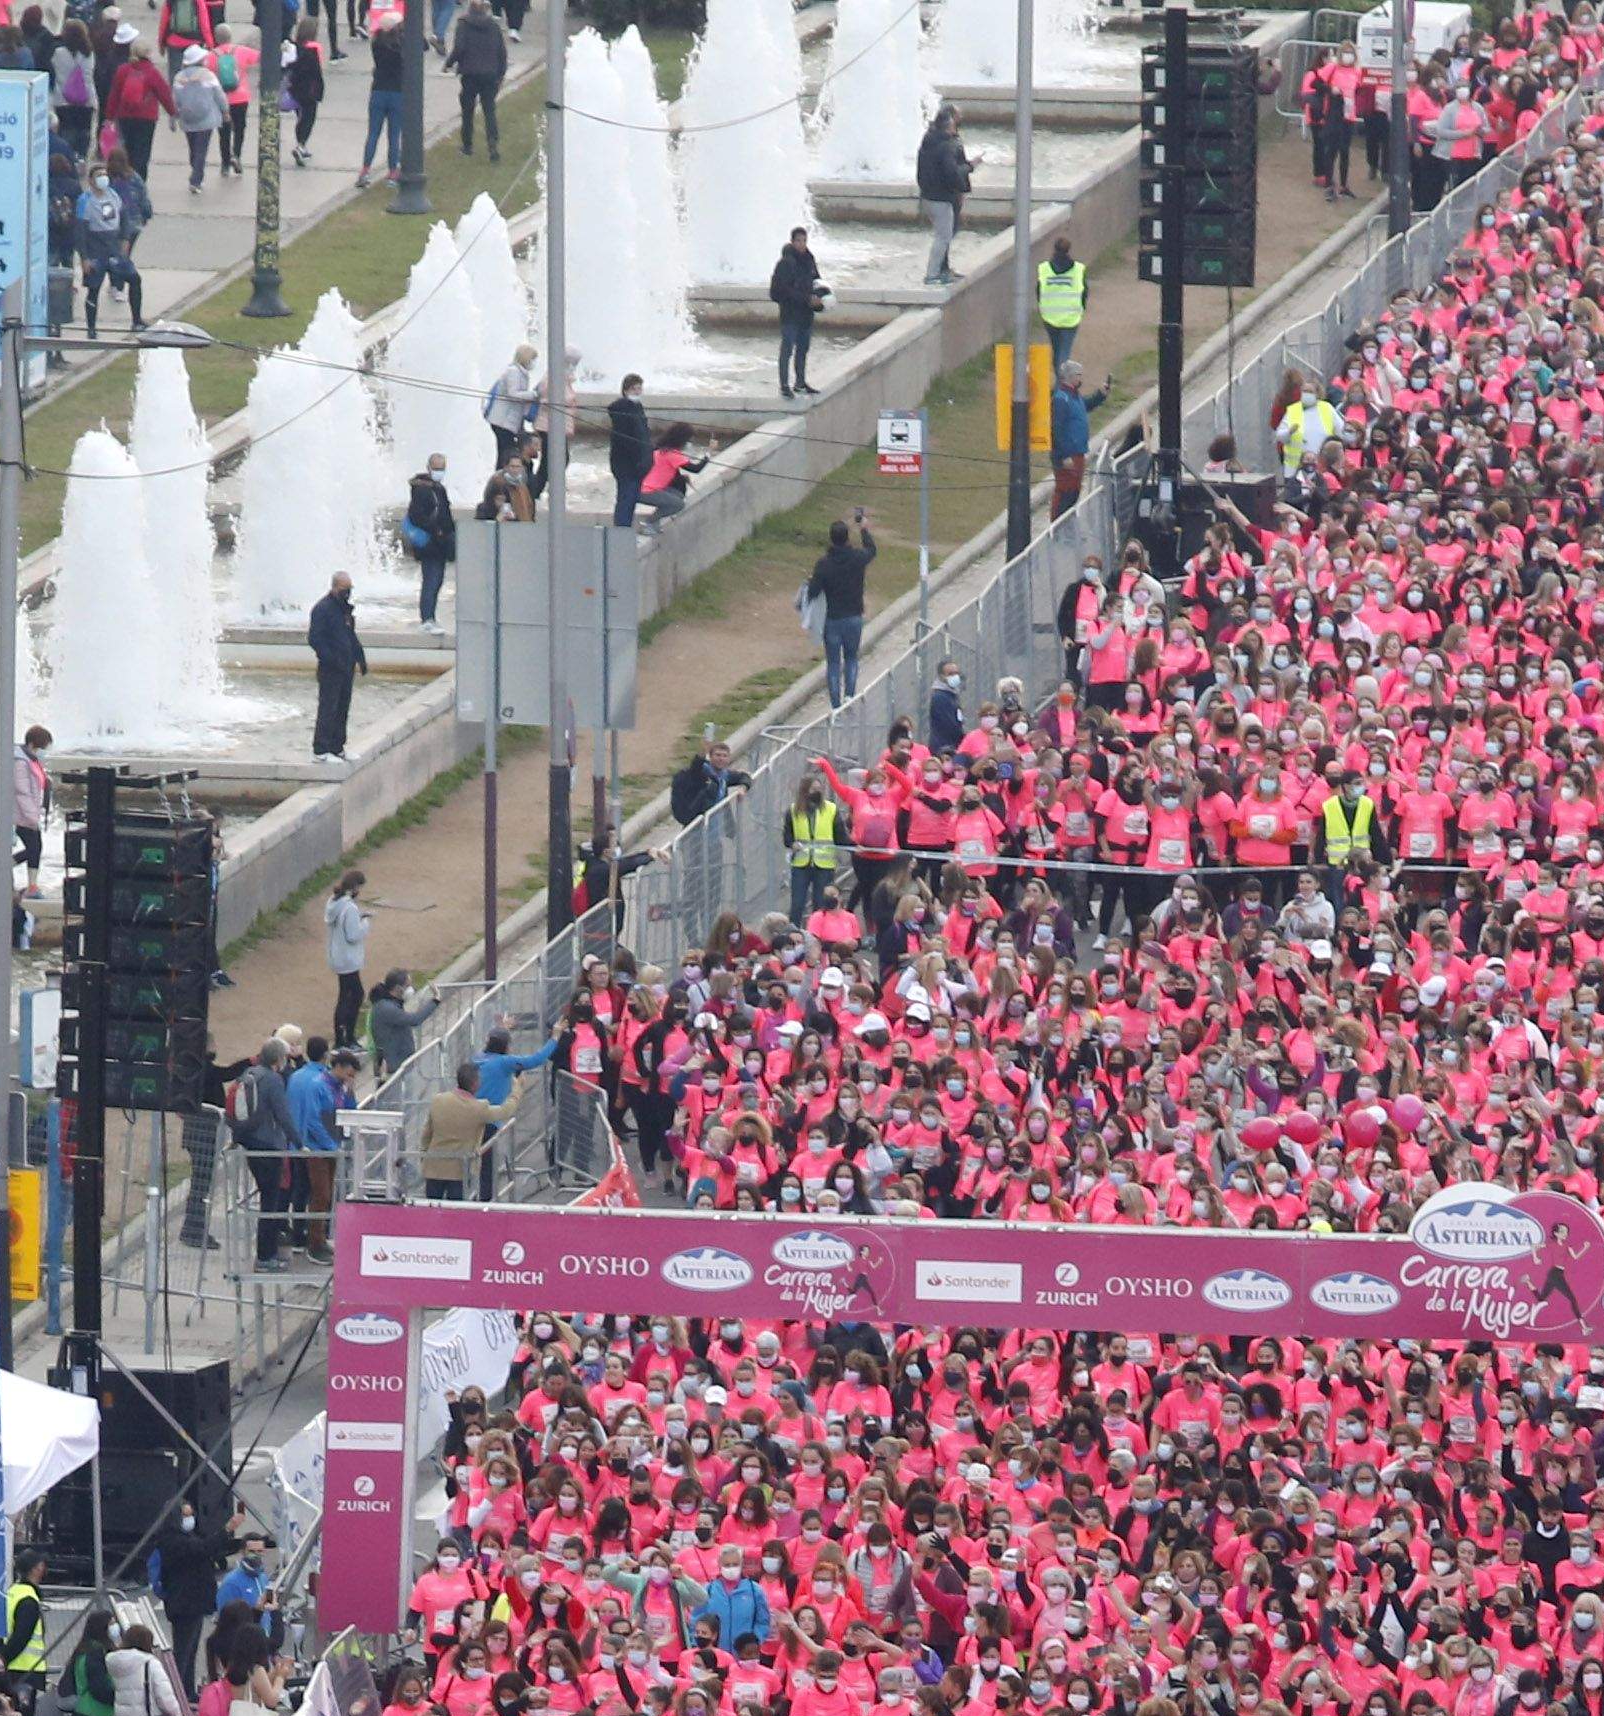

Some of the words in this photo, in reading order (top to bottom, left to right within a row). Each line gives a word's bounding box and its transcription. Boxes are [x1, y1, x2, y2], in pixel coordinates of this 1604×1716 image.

[1422, 1220, 1533, 1247] ASTURIANA
[391, 1251, 460, 1266] Santander
[779, 1243, 848, 1260] ASTURIANA
[559, 1254, 650, 1277] OYSHO
[669, 1261, 745, 1281] ASTURIANA
[1399, 1254, 1511, 1290] Carrera
[482, 1269, 544, 1285] ZURICH
[764, 1265, 833, 1288] Carrera
[944, 1275, 1012, 1290] Santander
[1104, 1275, 1194, 1298] OYSHO
[1208, 1283, 1286, 1302] ASTURIANA
[1316, 1287, 1393, 1305] ASTURIANA
[802, 1286, 857, 1318] Mujer
[1035, 1291, 1098, 1306] ZURICH
[1425, 1292, 1445, 1312] de
[1449, 1292, 1465, 1312] la
[1462, 1286, 1549, 1339] Mujer
[330, 1374, 403, 1392] OYSHO
[336, 1499, 391, 1513] ZURICH
